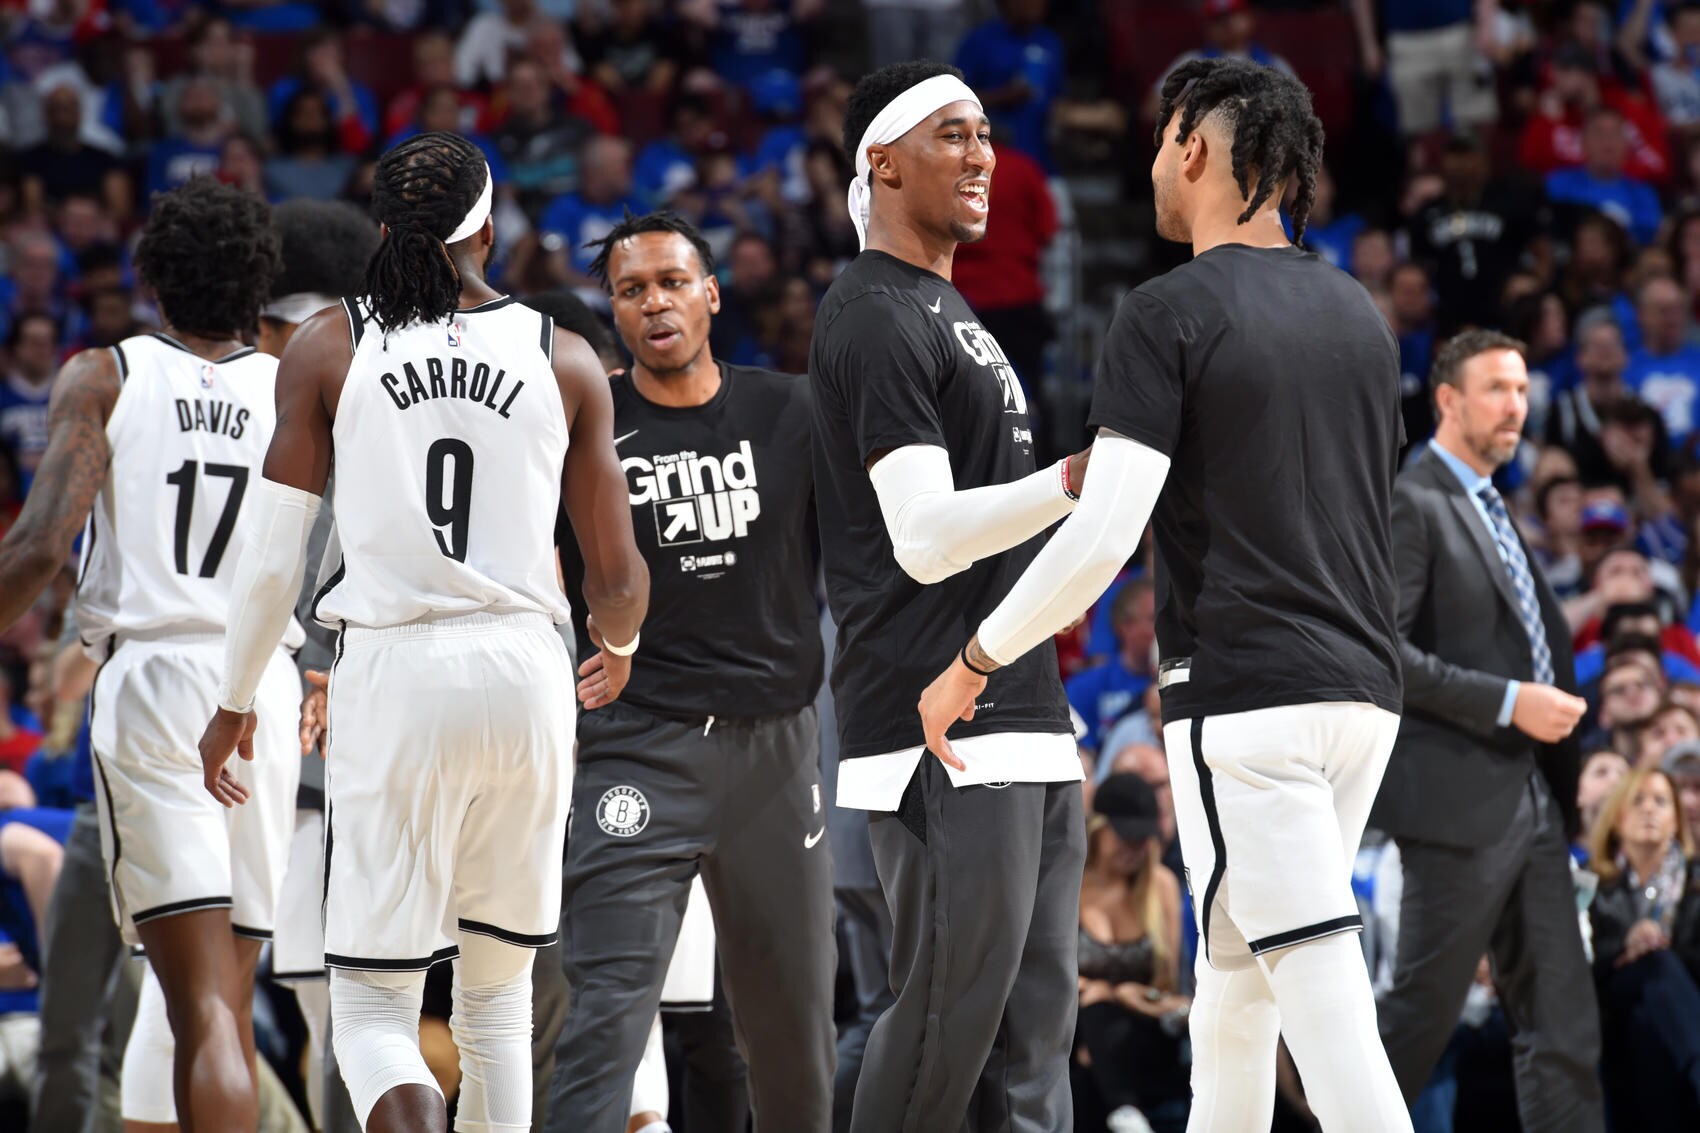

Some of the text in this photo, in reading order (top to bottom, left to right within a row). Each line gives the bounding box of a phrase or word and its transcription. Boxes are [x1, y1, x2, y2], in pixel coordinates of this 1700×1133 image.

[380, 357, 525, 420] CARROLL
[175, 399, 250, 440] DAVIS
[620, 440, 757, 505] Grind
[653, 450, 697, 465] From the
[166, 459, 250, 579] 17
[425, 437, 475, 564] 9
[699, 488, 761, 541] UP
[603, 788, 647, 810] BROOKLYN
[616, 800, 629, 823] B
[600, 818, 640, 835] NEW YORK
